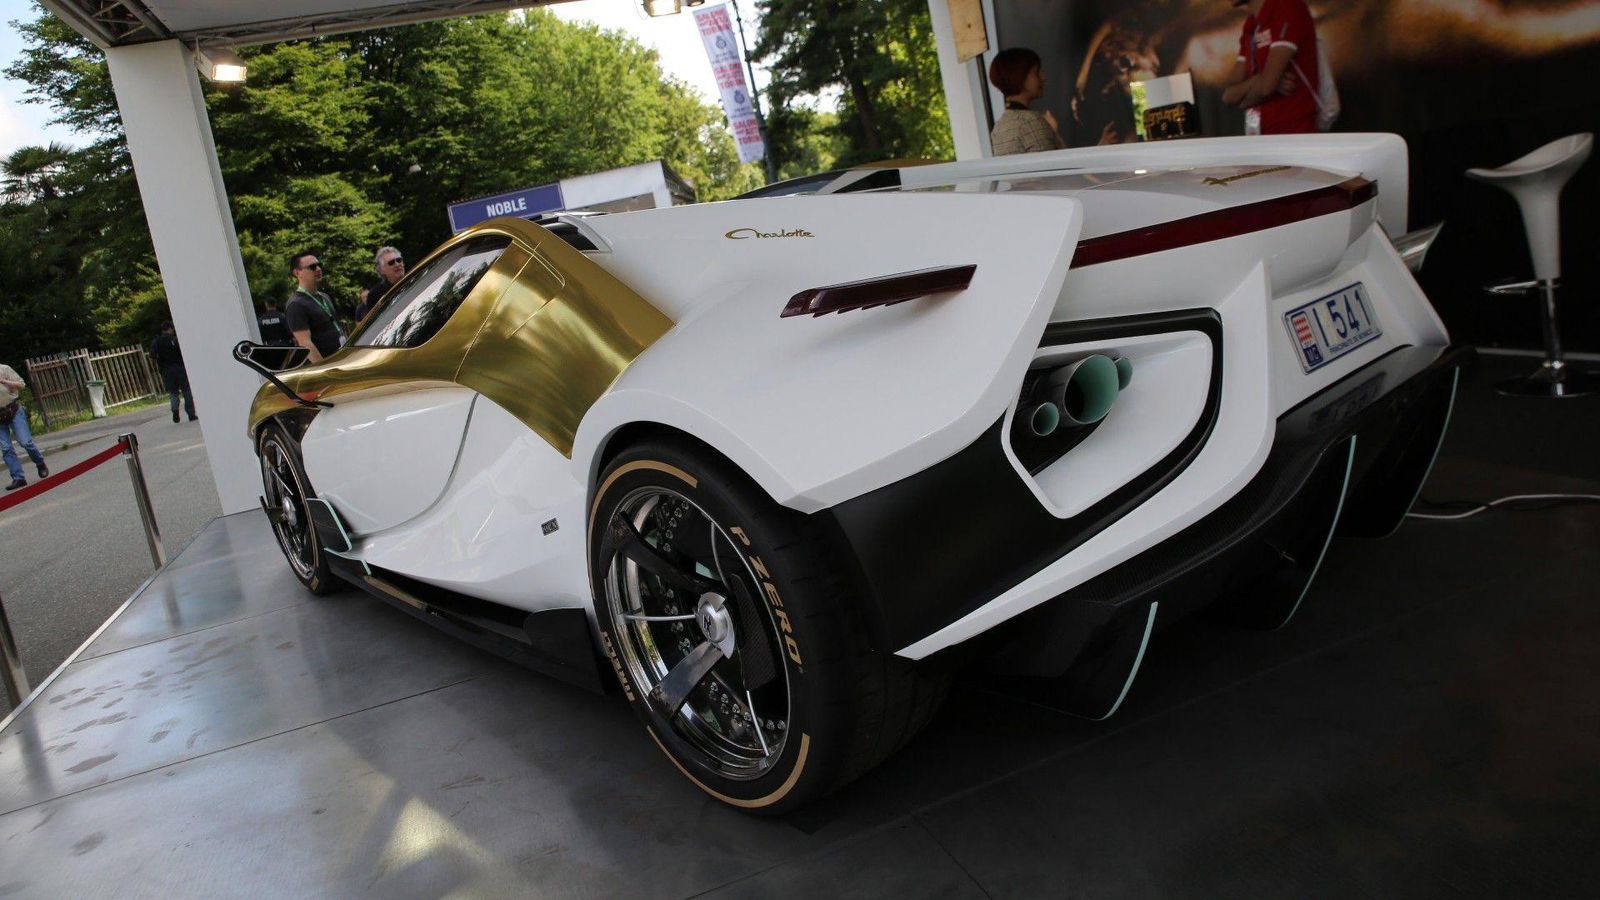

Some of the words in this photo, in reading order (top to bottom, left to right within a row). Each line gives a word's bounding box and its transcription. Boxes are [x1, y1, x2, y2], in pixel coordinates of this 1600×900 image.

[486, 197, 527, 217] NOBLE
[725, 228, 815, 240] Charlotte
[729, 526, 751, 546] P
[749, 555, 803, 665] ZERO
